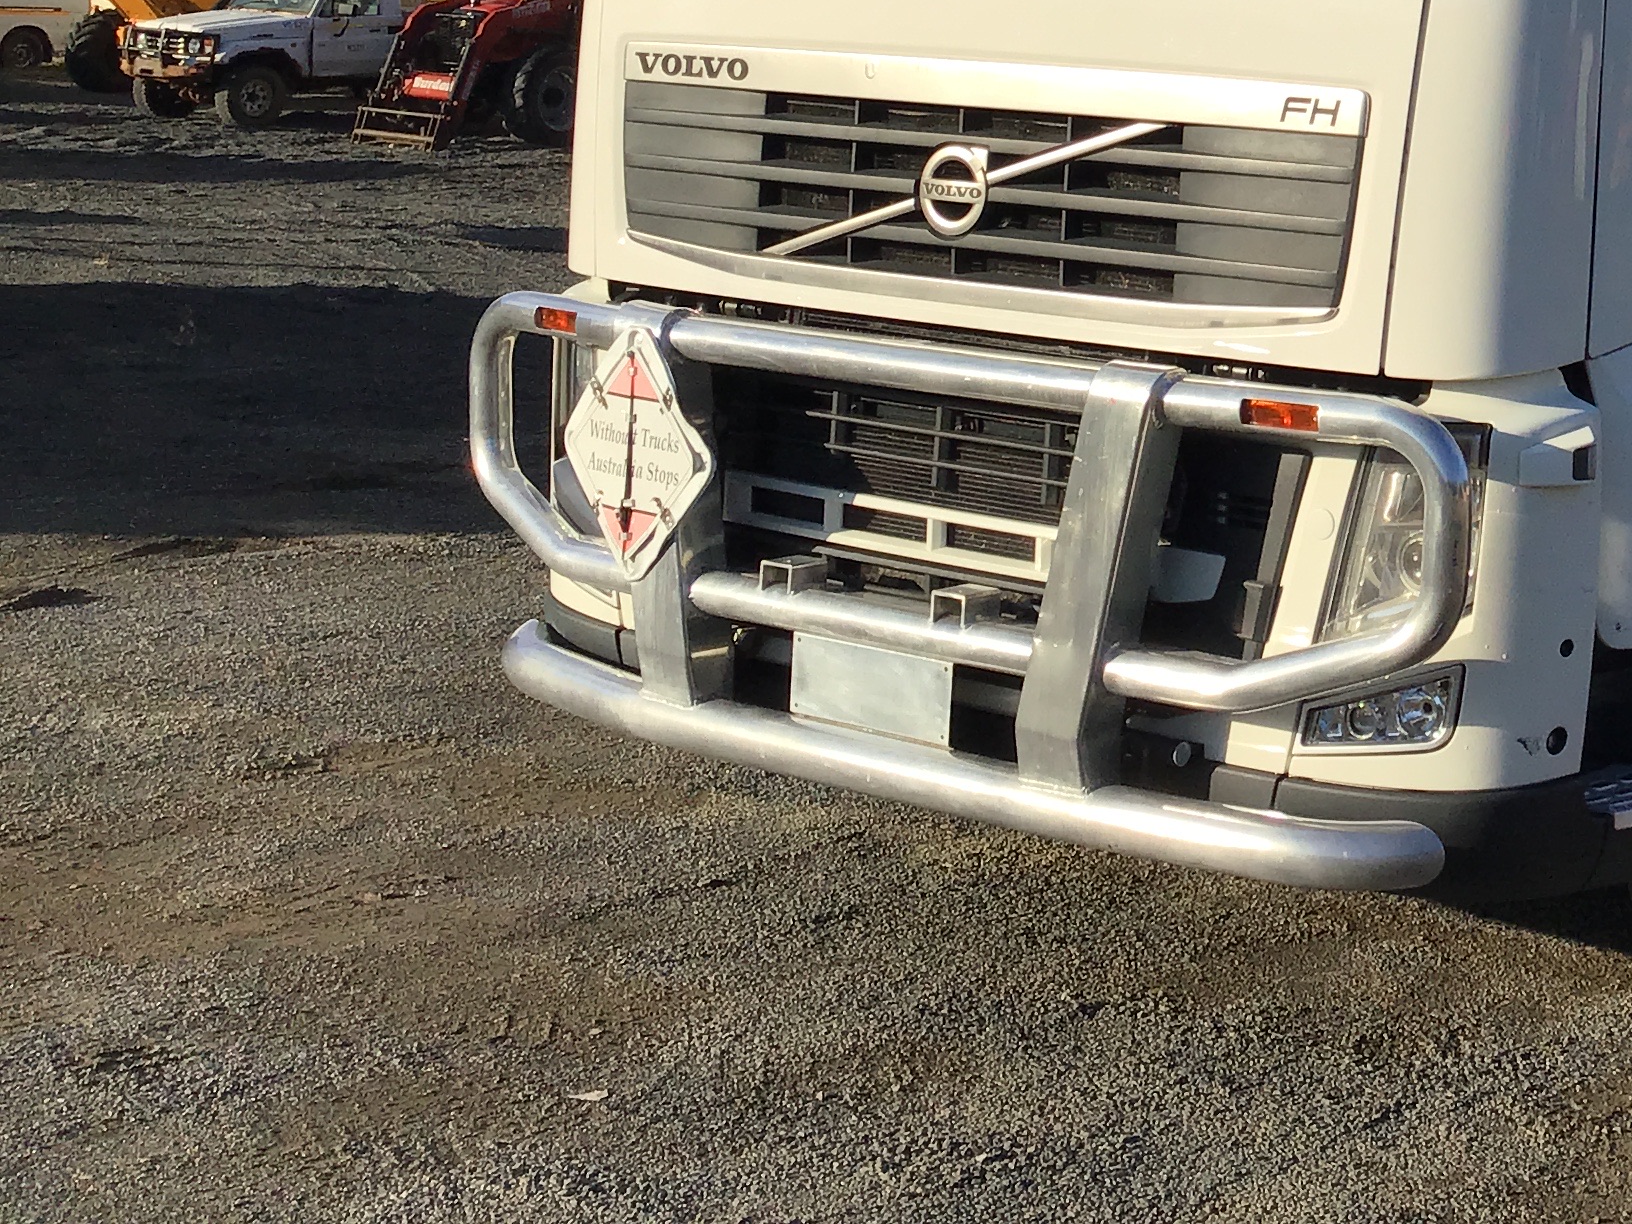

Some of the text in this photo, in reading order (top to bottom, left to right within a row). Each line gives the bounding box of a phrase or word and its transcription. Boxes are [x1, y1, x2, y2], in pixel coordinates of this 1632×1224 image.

[634, 51, 749, 82] VOLVO
[1279, 96, 1342, 127] FH
[922, 182, 983, 199] VOLVO
[589, 418, 680, 454] Without Trucks
[646, 461, 680, 491] Stops
